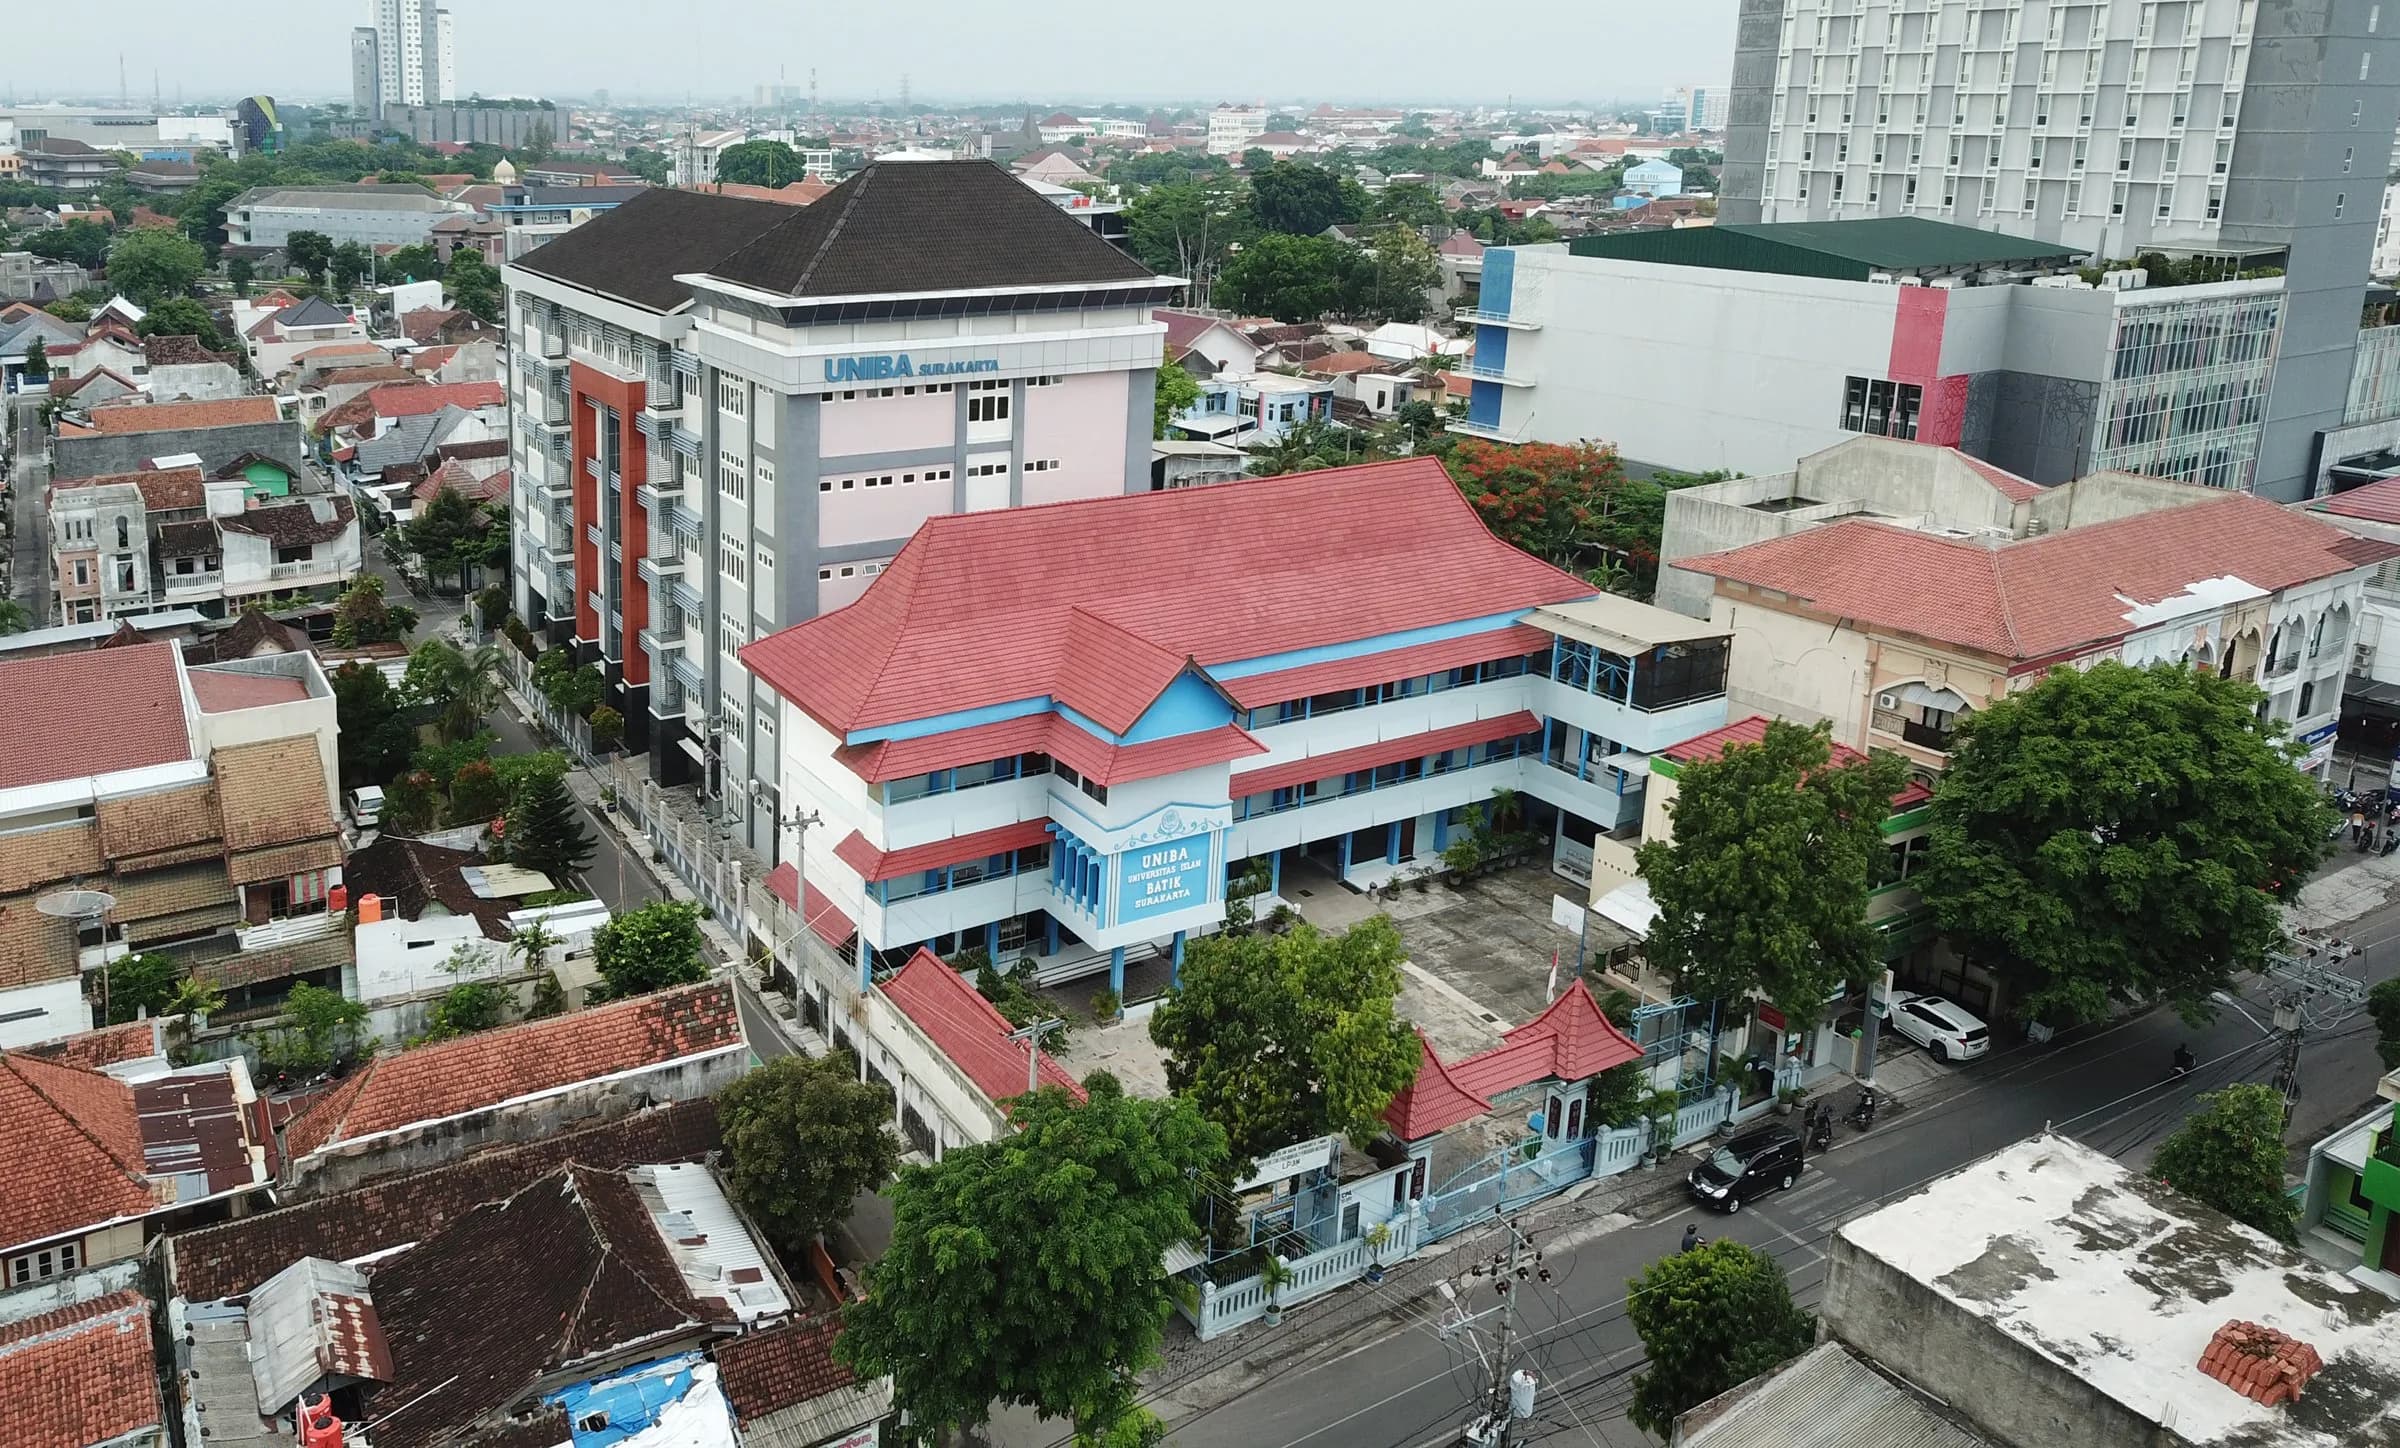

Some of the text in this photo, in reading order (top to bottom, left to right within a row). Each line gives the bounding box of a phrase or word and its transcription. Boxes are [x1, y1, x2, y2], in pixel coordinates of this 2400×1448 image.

[824, 353, 999, 383] UNIBA SURAKARTA
[1142, 847, 1189, 869] UNIBA
[1127, 859, 1202, 884] UNIVERSITAS ISLAM
[1146, 876, 1182, 895] BATIK
[1135, 889, 1191, 909] SURAKARTA
